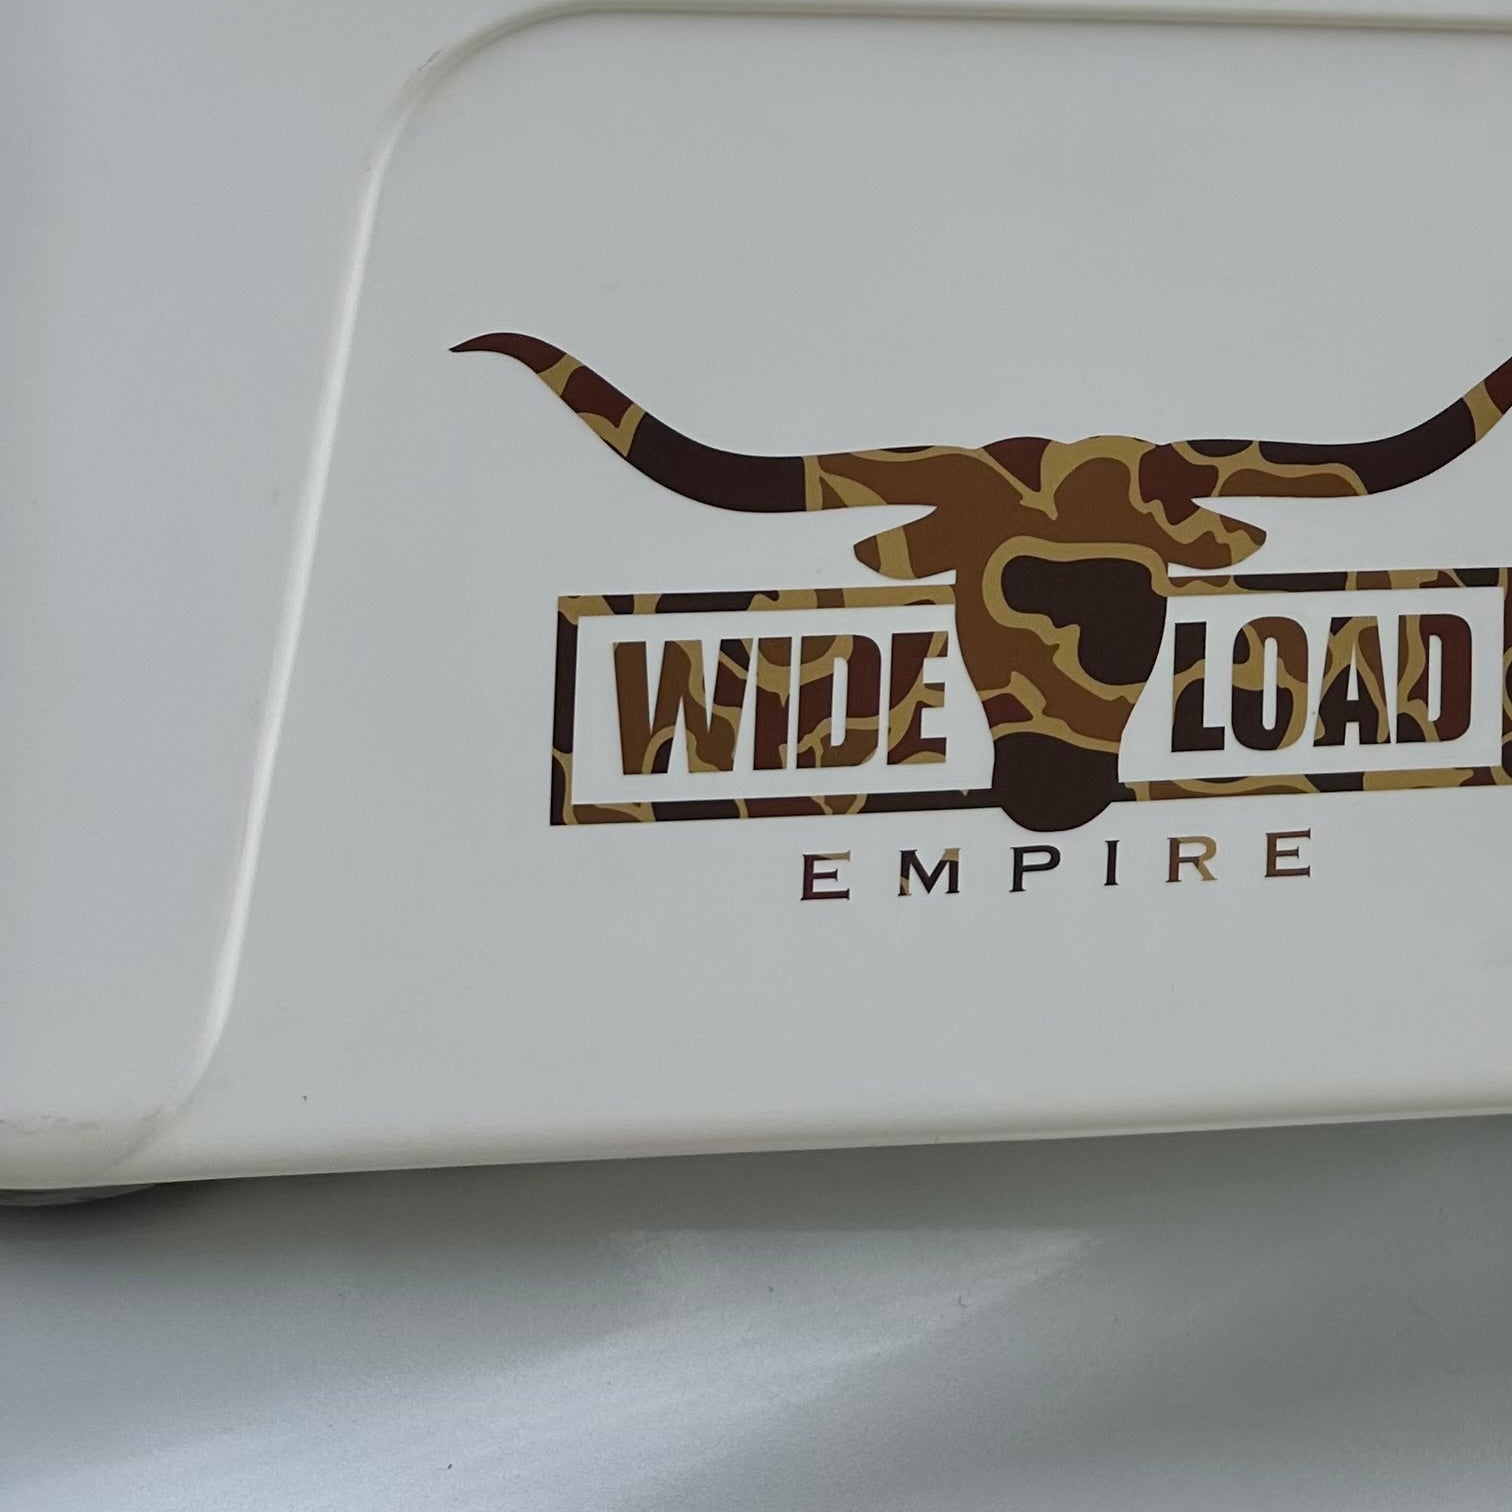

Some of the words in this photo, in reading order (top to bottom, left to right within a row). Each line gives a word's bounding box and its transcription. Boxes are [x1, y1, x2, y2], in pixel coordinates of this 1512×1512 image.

[613, 631, 948, 774] WIDE
[1170, 613, 1472, 752] LOAD
[800, 828, 1312, 901] EMPIRE
